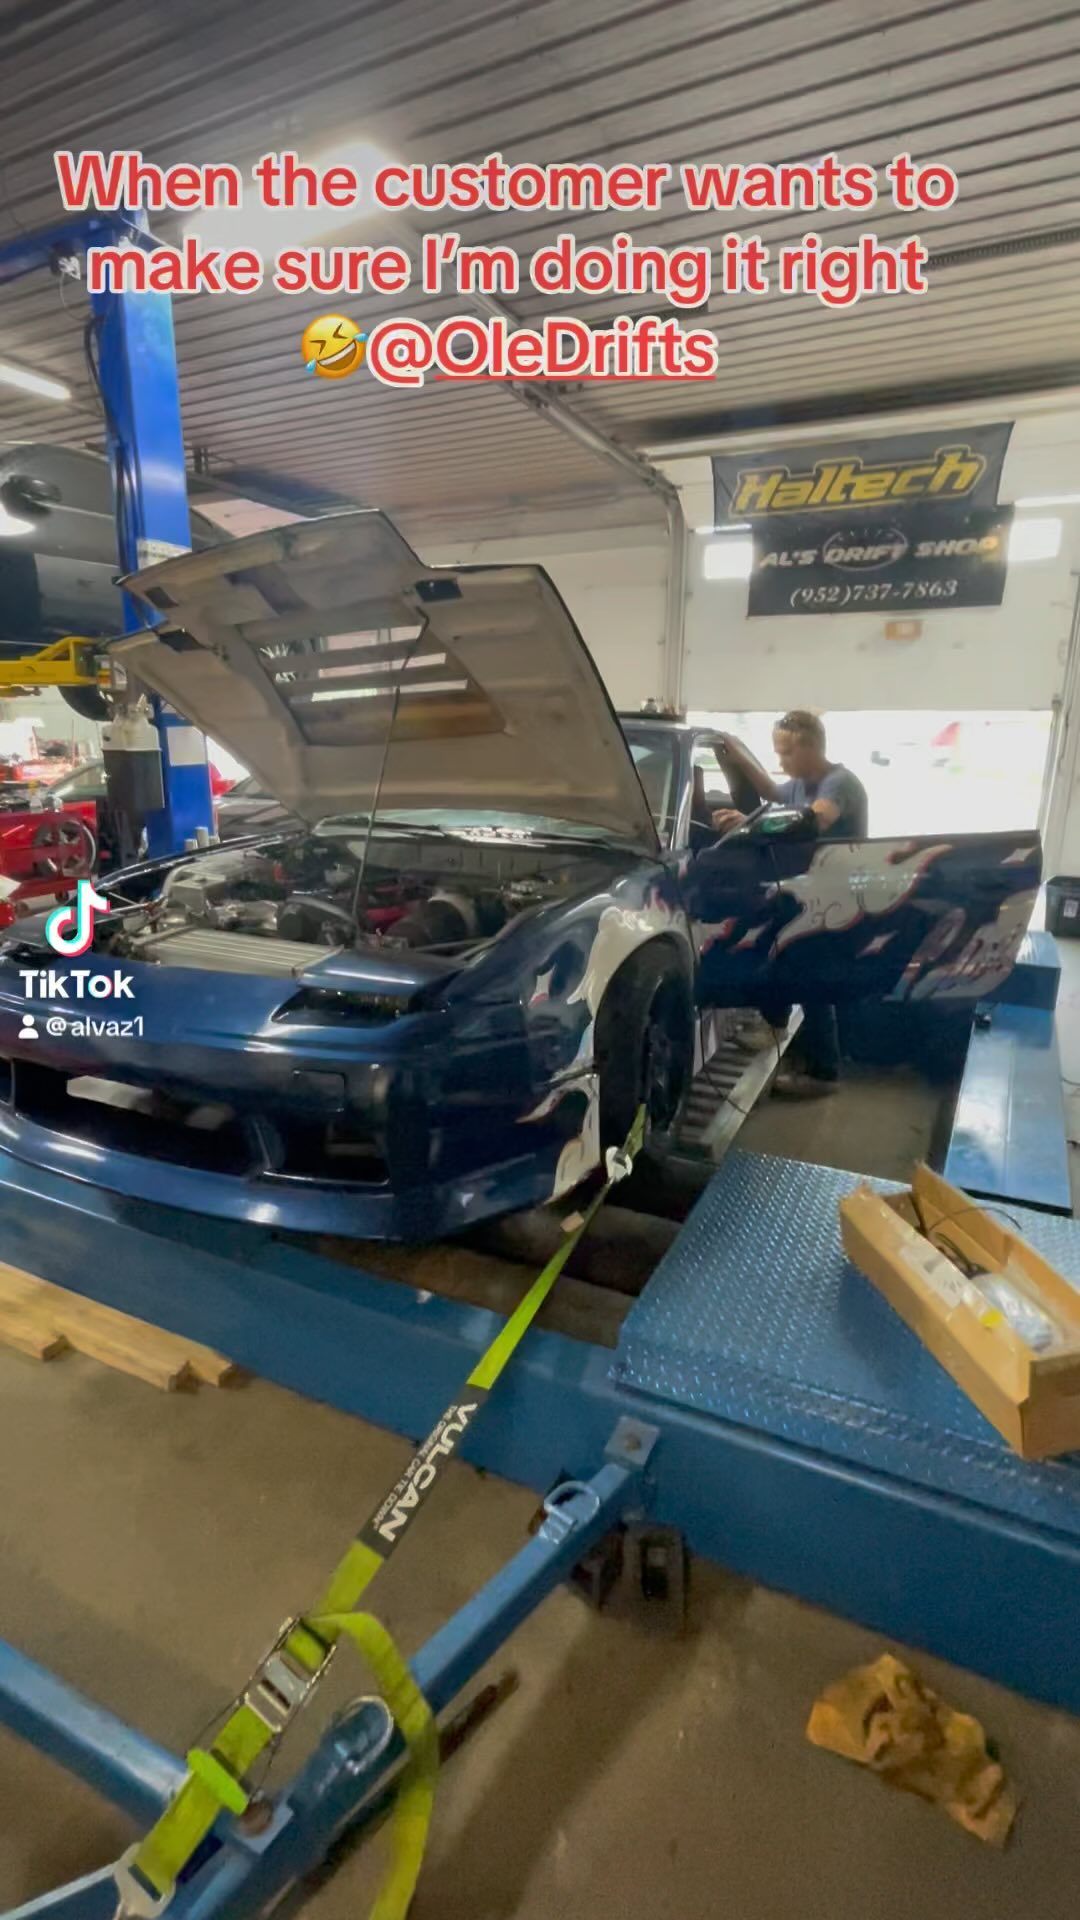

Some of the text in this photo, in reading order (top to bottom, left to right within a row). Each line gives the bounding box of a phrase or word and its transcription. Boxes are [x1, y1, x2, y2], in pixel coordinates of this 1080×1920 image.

[733, 446, 986, 514] Haltech
[760, 537, 999, 568] AL'S DRIFT SHOP
[790, 580, 957, 607] (952)737-7863
[379, 1403, 478, 1542] VULCAN
